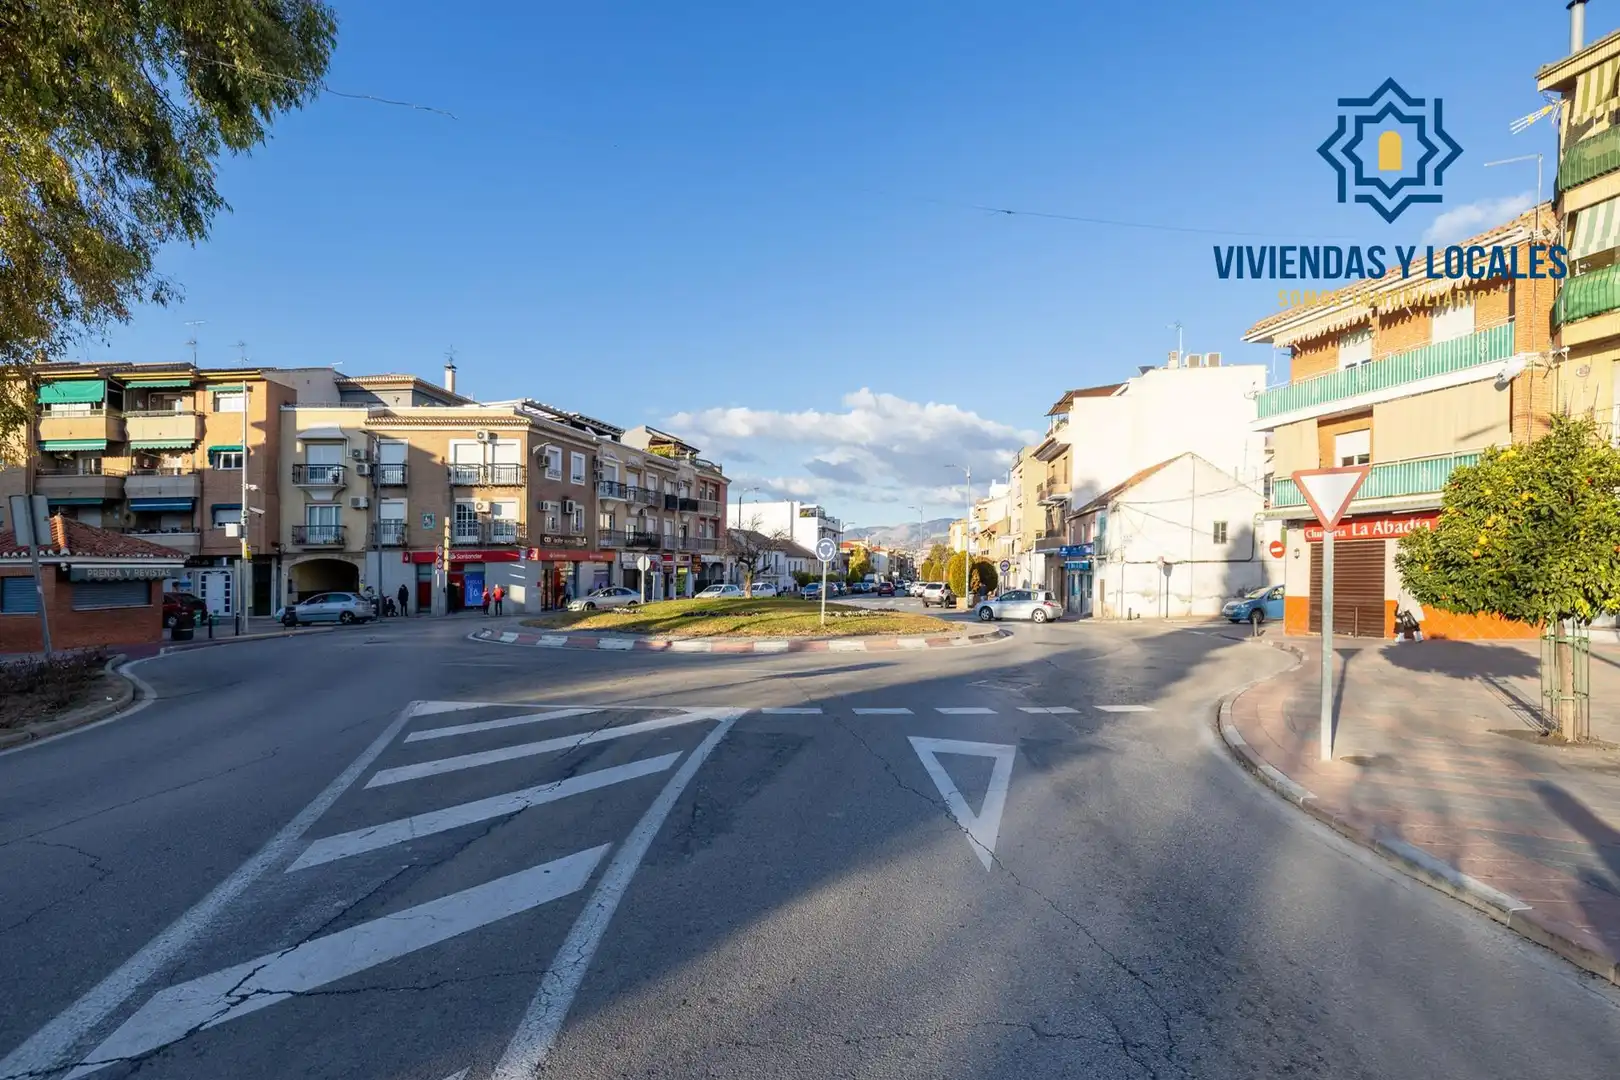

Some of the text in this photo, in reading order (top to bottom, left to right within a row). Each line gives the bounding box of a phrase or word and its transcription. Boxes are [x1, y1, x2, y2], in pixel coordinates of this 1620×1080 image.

[1352, 523, 1368, 536] La
[87, 568, 172, 578] PRENSA Y REVISTAS
